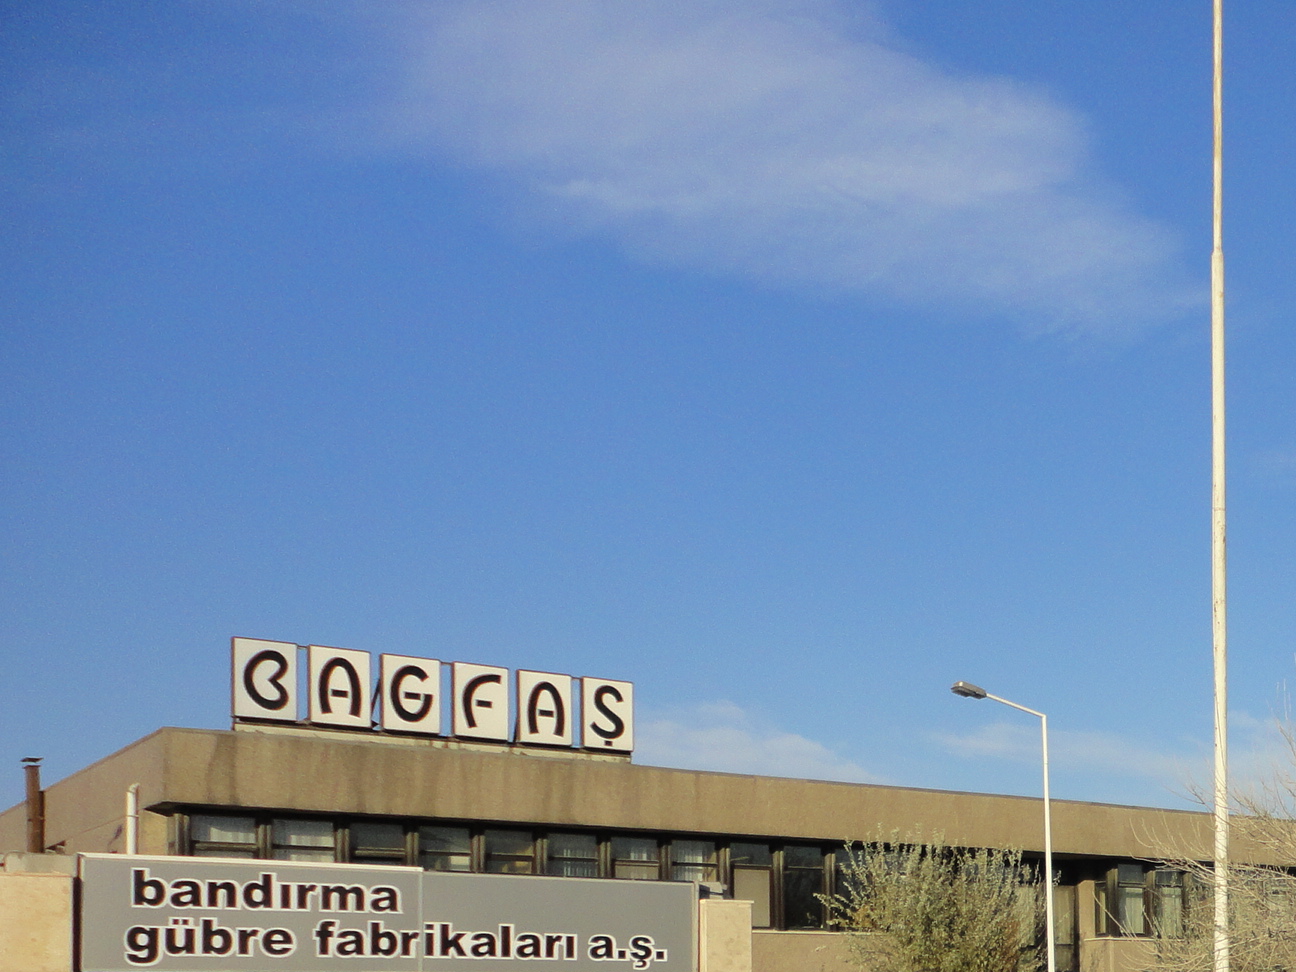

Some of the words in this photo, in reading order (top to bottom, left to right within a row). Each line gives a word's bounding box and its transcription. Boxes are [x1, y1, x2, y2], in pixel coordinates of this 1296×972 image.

[243, 649, 625, 748] BAGFAŞ
[131, 868, 402, 913] bandırma
[125, 917, 296, 966] gübre
[313, 919, 577, 960] fabrikaları
[588, 934, 668, 970] a.ş.
